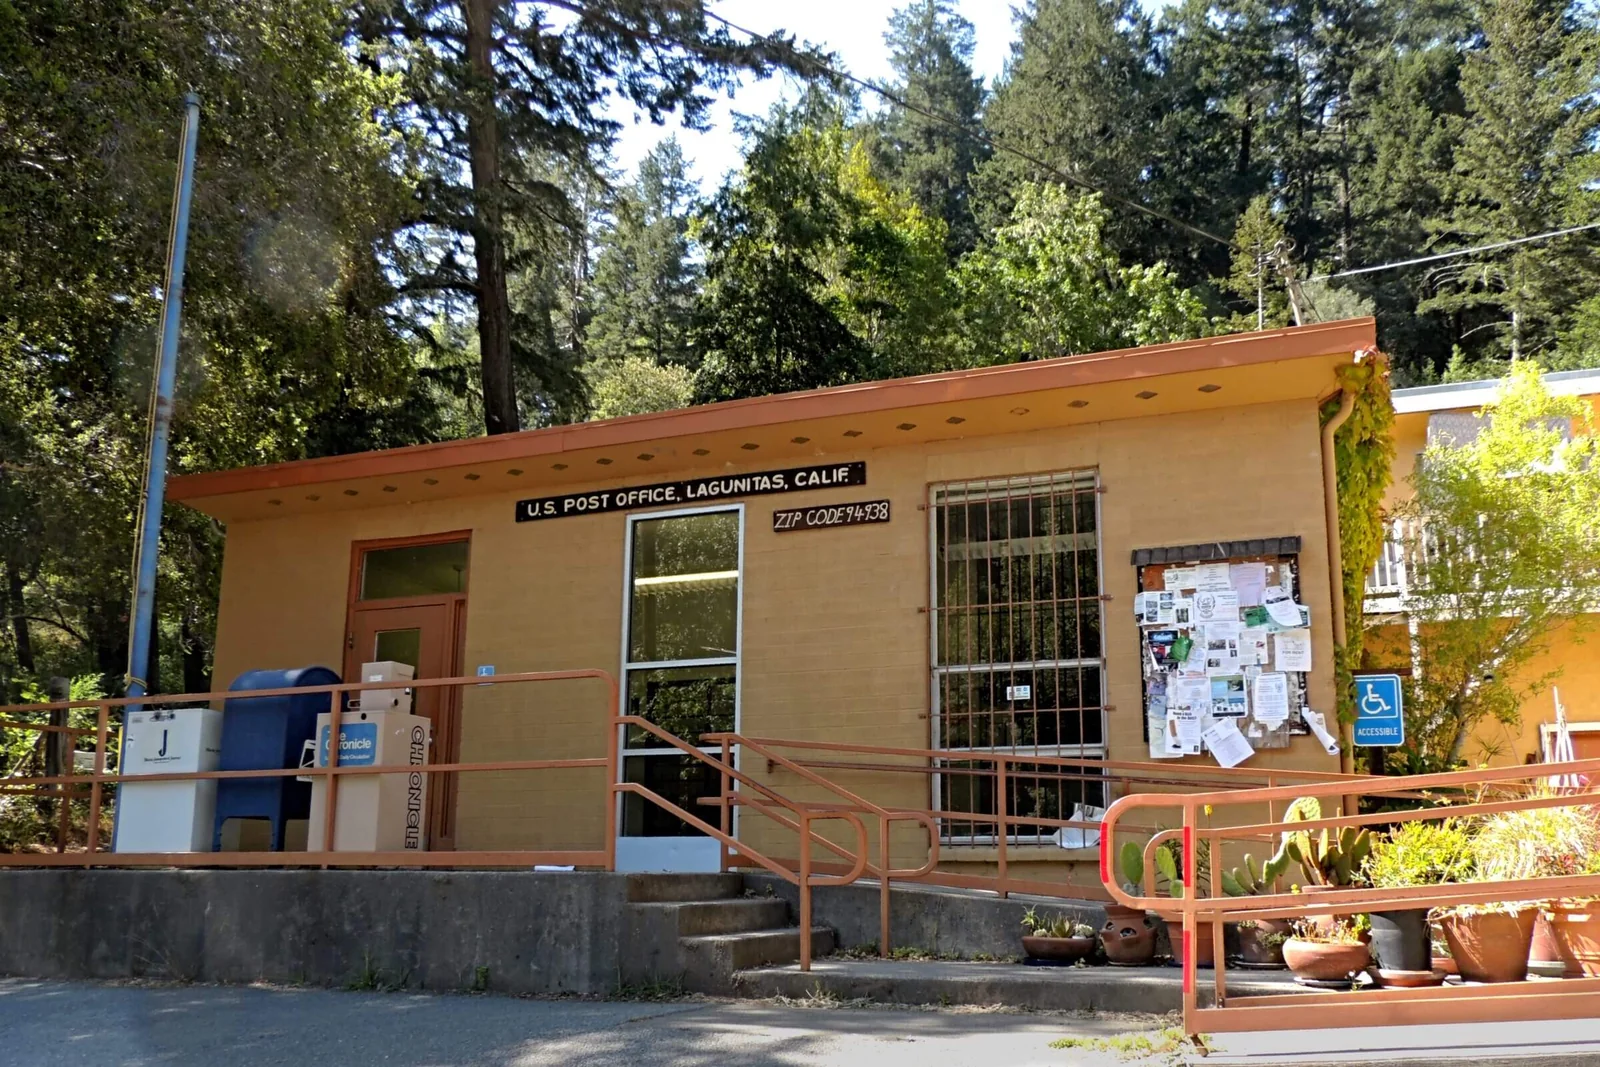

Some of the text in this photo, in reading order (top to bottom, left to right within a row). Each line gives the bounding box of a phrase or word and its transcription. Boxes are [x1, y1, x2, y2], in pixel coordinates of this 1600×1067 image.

[527, 467, 849, 517] U.S. POST OFFICE, LAGUNITAS, CALIF.
[774, 513, 801, 529] ZIP
[158, 729, 168, 757] J
[1358, 727, 1399, 737] ACCESSIBLE
